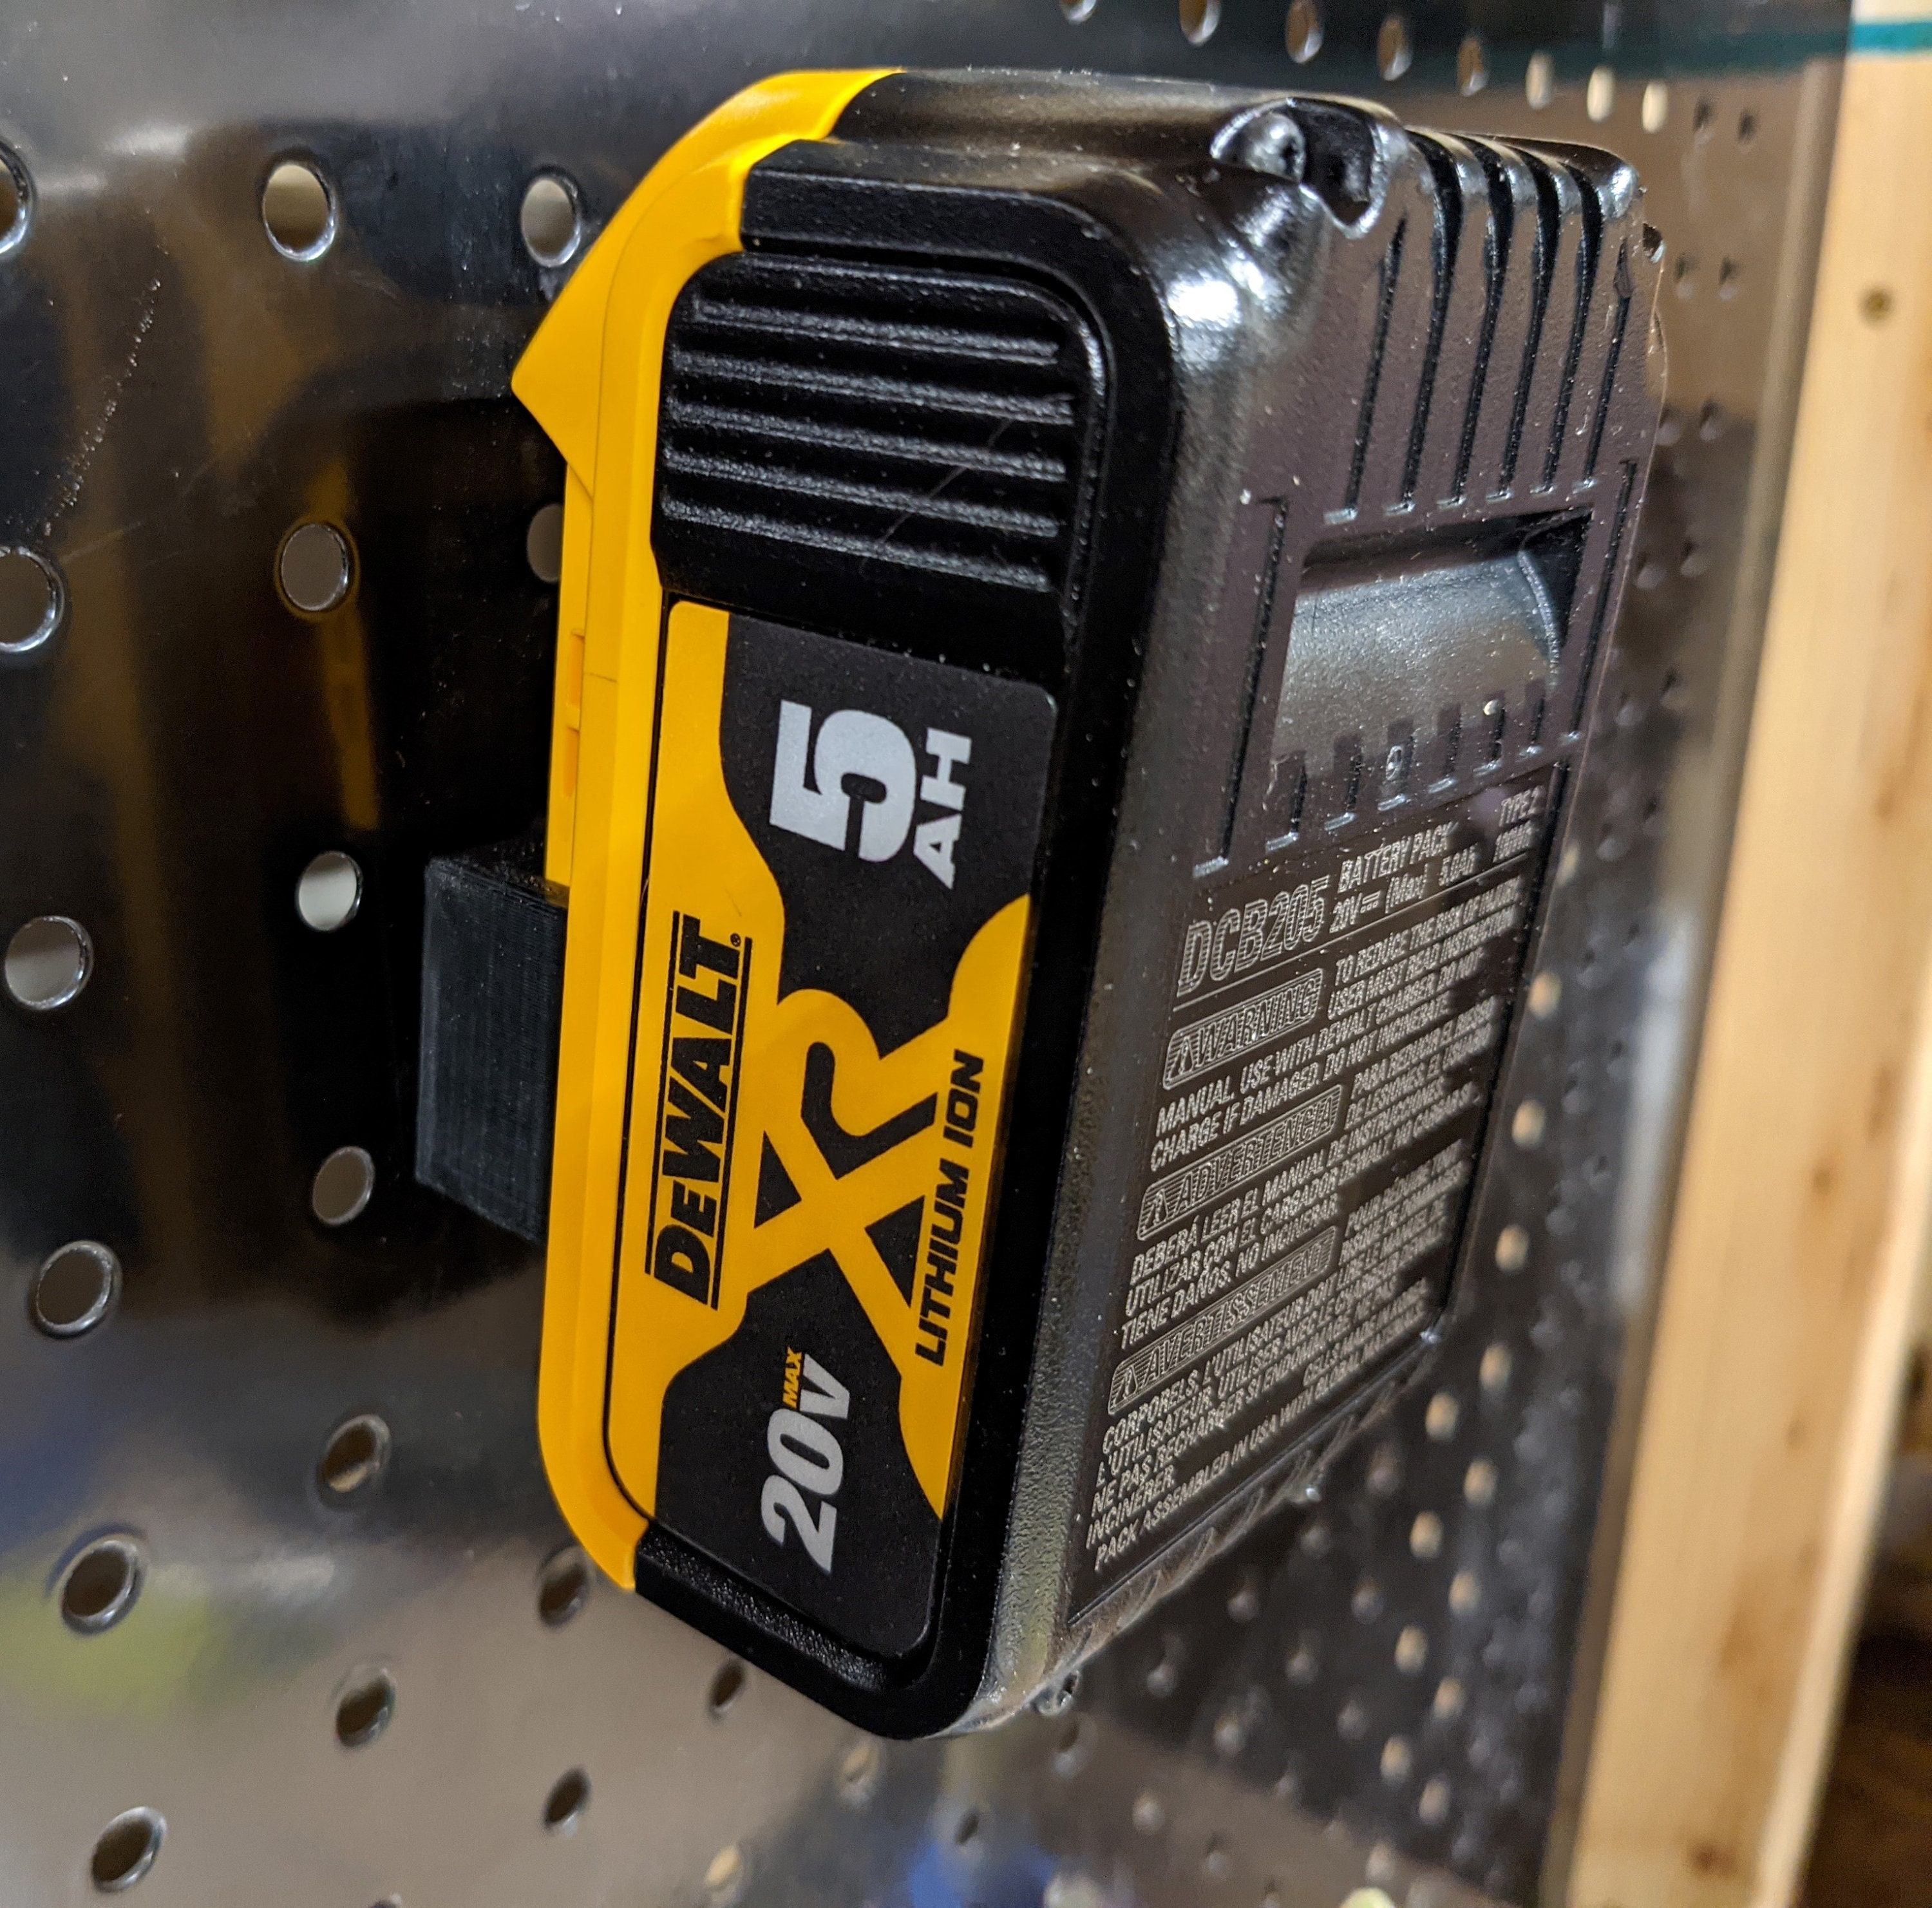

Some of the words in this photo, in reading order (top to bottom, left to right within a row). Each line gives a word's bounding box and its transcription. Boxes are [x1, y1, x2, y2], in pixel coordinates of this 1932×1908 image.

[769, 699, 914, 863] 5
[914, 727, 972, 888] AH
[1336, 835, 1413, 894] BATTERY
[1408, 819, 1454, 865] PACK
[1176, 871, 1331, 999] DCB205
[1325, 976, 1368, 1022] USER
[1364, 958, 1407, 1003] MUST
[1404, 940, 1441, 983] READ
[1331, 952, 1356, 988] TO
[1353, 928, 1410, 978] REDUCE
[1406, 915, 1436, 952] THE
[1432, 902, 1464, 940] RISK
[1461, 893, 1481, 926] OF
[1155, 1070, 1238, 1138] MANUAL.
[1238, 1053, 1274, 1097] USE
[1273, 1032, 1316, 1079] WITH
[1315, 1001, 1377, 1057] DEWALT
[1436, 959, 1457, 992] DO
[1455, 946, 1482, 982] NOT
[1193, 974, 1320, 1072] WARNING
[1350, 1056, 1388, 1100] PARA
[1385, 1026, 1441, 1080] REDUCIR
[1438, 1017, 1456, 1048] EL
[940, 1049, 984, 1146] ION
[1149, 1109, 1223, 1175] CHARGE
[1222, 1100, 1241, 1136] IF
[1239, 1057, 1323, 1126] DAMAGED.
[1321, 1045, 1347, 1082] DO
[1345, 1028, 1378, 1069] NOT
[1174, 1093, 1335, 1218] ADVERTENCIA
[1343, 1095, 1366, 1131] DE
[747, 988, 946, 1372] XR
[1123, 1247, 1202, 1320] UTILIZAR
[1202, 1225, 1240, 1272] CON
[1238, 1213, 1260, 1249] EL
[1258, 1163, 1340, 1238] CARGADOR
[1130, 1213, 1202, 1286] DEBERÁ
[1200, 1195, 1242, 1244] LEER
[1241, 1183, 1262, 1219] EL
[1261, 1145, 1327, 1207] MANUAL
[1325, 1132, 1349, 1168] DE
[915, 1158, 969, 1366] LITHIUM
[1119, 1295, 1171, 1352] TIENE
[1235, 1240, 1260, 1278] NO
[1143, 1238, 1324, 1390] AVERTISSEMENT
[1202, 1292, 1305, 1386] L'UTILISATEUR
[1303, 1270, 1337, 1316] DOIT
[1363, 1238, 1382, 1272] LE
[781, 1346, 804, 1409] MAX
[1216, 1335, 1281, 1403] UTILISER
[1281, 1308, 1319, 1355] AVEC
[1316, 1296, 1336, 1329] LE
[1301, 1341, 1340, 1388] CELLS
[761, 1354, 851, 1571] 20V
[1090, 1478, 1117, 1520] NE
[1117, 1452, 1153, 1500] PAS
[1152, 1386, 1245, 1474] RECHARGER
[1245, 1374, 1262, 1405] SI
[1094, 1515, 1139, 1573] PACK
[1140, 1446, 1231, 1536] ASSEMBLED
[1230, 1431, 1250, 1468] IN
[1247, 1409, 1280, 1455] USA
